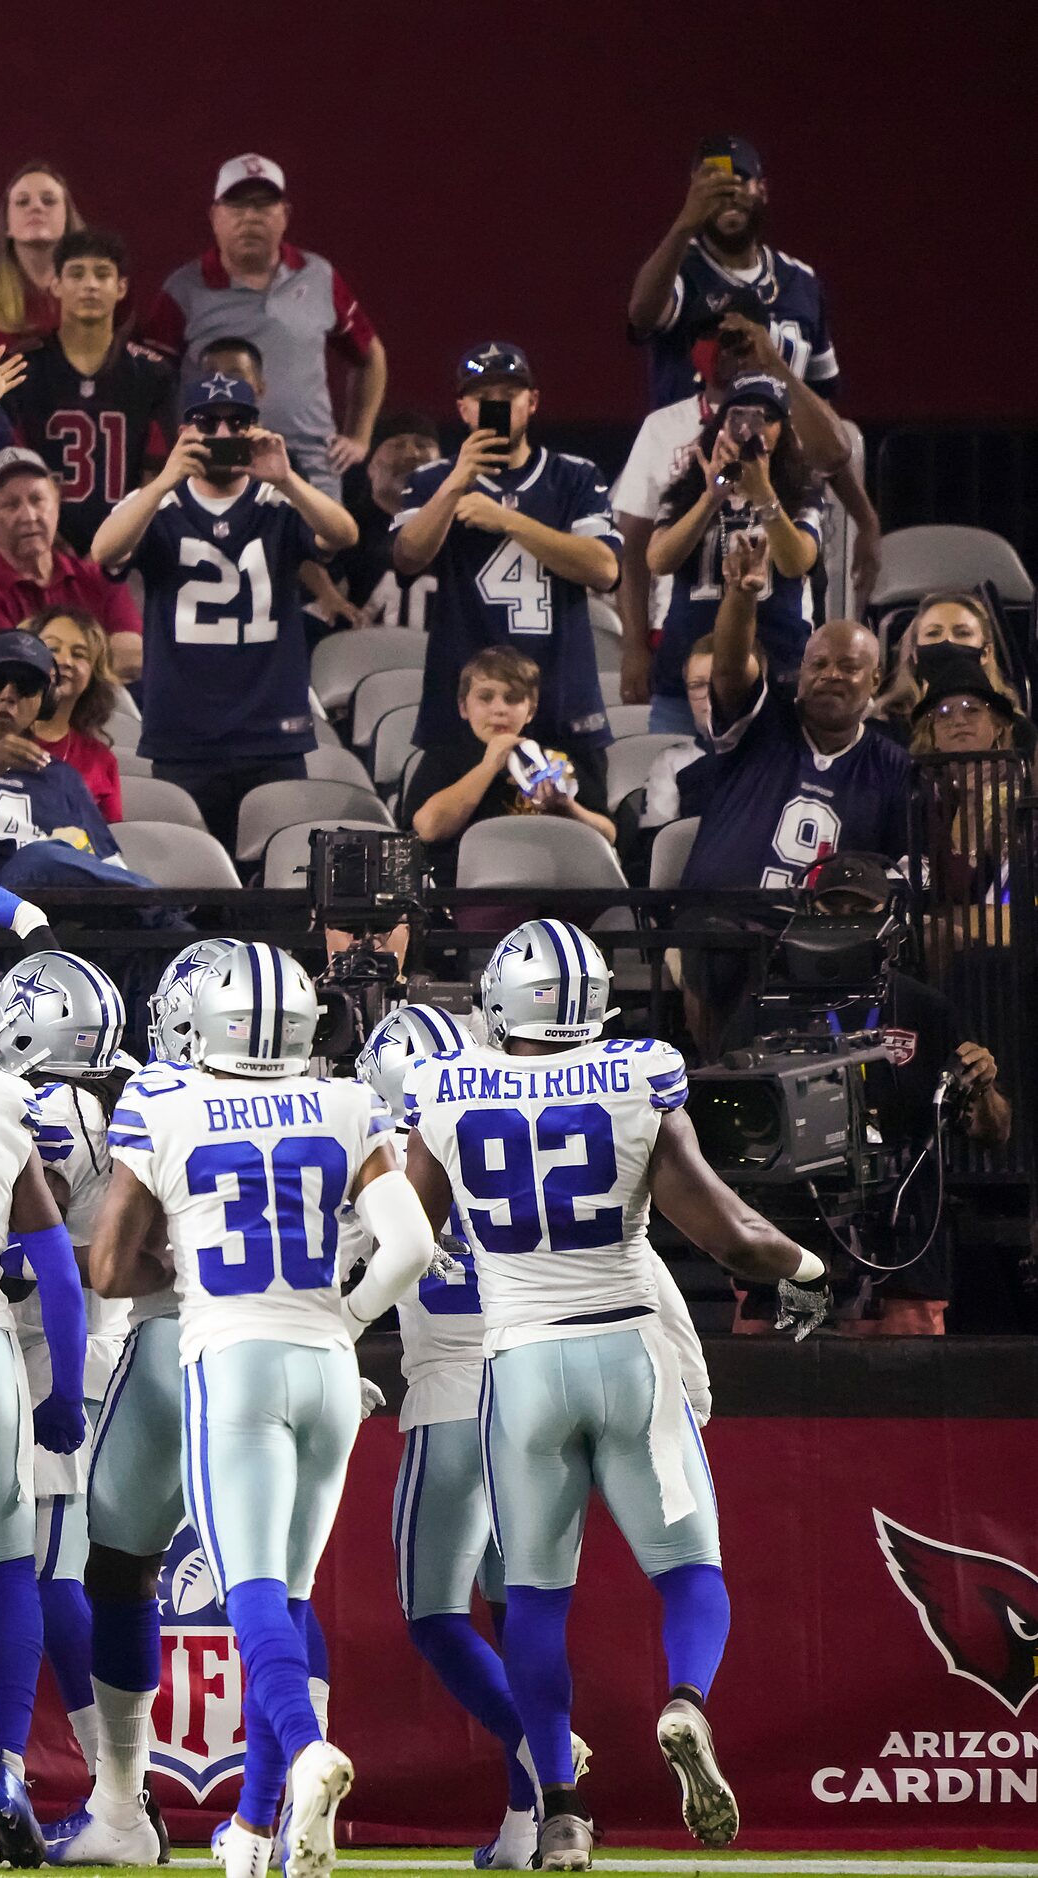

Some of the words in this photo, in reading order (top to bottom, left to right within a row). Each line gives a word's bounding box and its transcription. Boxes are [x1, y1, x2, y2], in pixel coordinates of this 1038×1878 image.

[46, 410, 126, 503] 31
[175, 537, 279, 644] 21
[474, 537, 553, 635] 4
[235, 1062, 285, 1072] COWBOYS
[544, 1028, 591, 1038] COWBOYS
[203, 1091, 323, 1132] BROWN
[436, 1059, 630, 1103] ARMSTRONG
[185, 1137, 347, 1296] 30
[456, 1102, 624, 1254] 92
